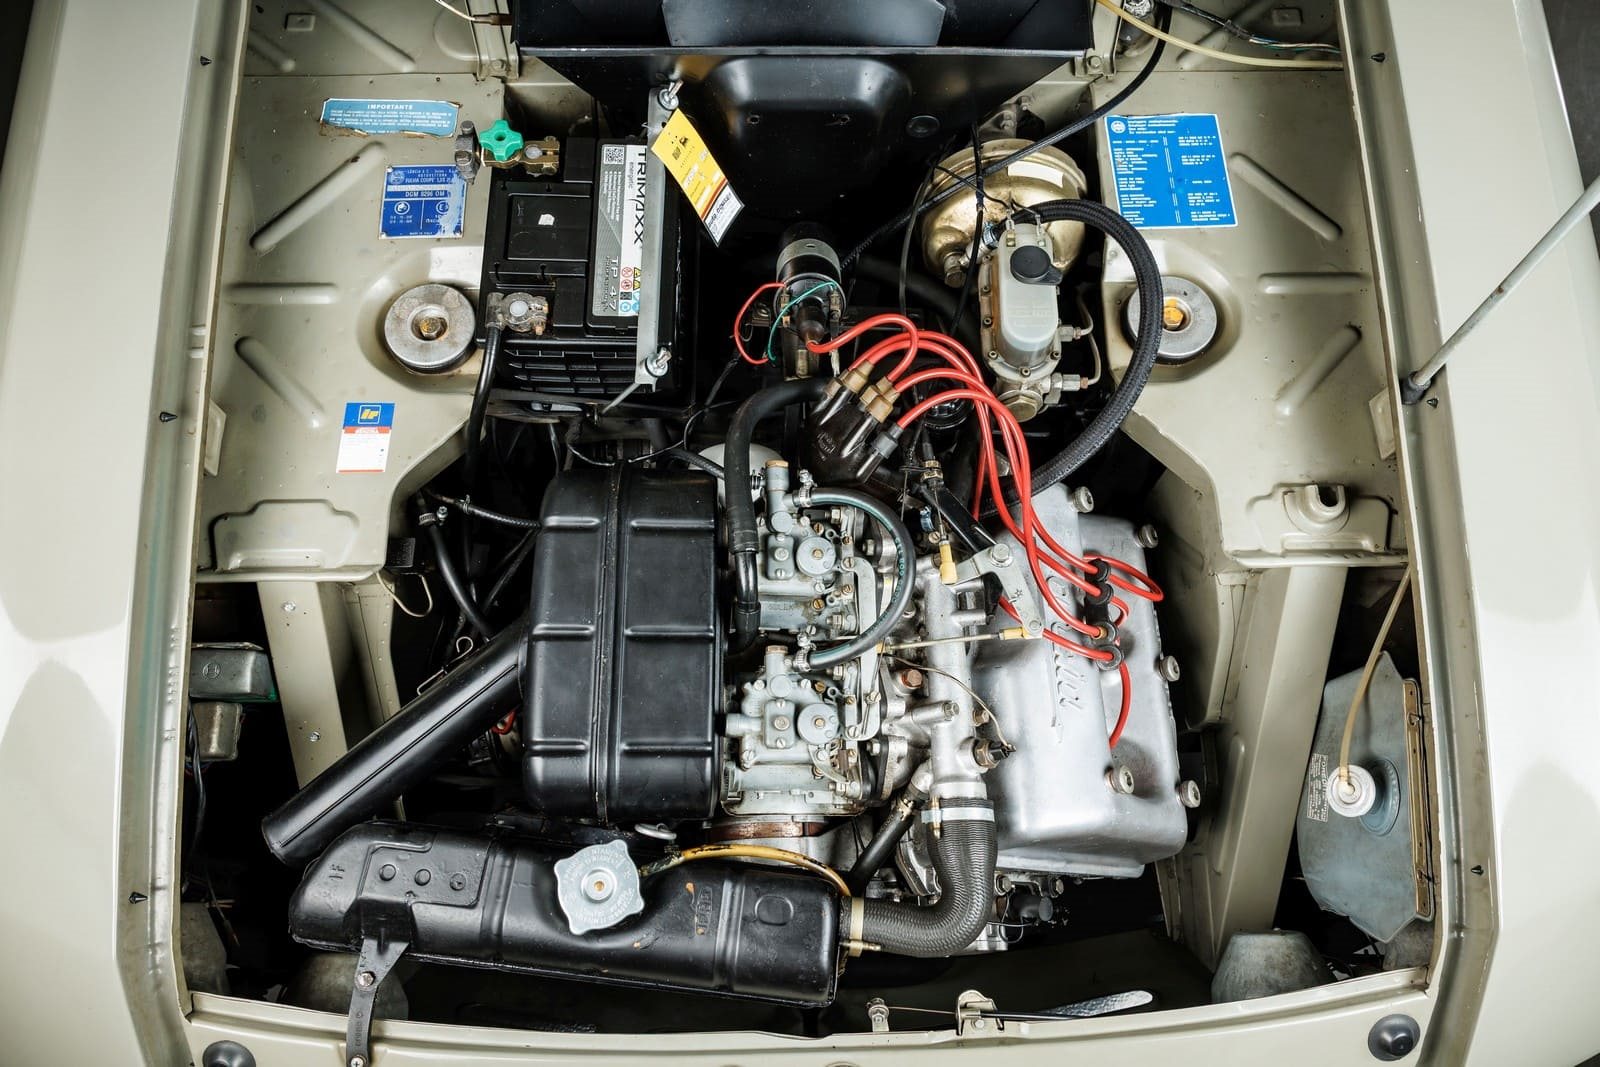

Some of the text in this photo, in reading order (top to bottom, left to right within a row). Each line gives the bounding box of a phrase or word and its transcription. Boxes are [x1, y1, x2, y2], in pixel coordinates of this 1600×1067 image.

[629, 148, 647, 244] TRIMAXX
[609, 255, 619, 311] TP 47
